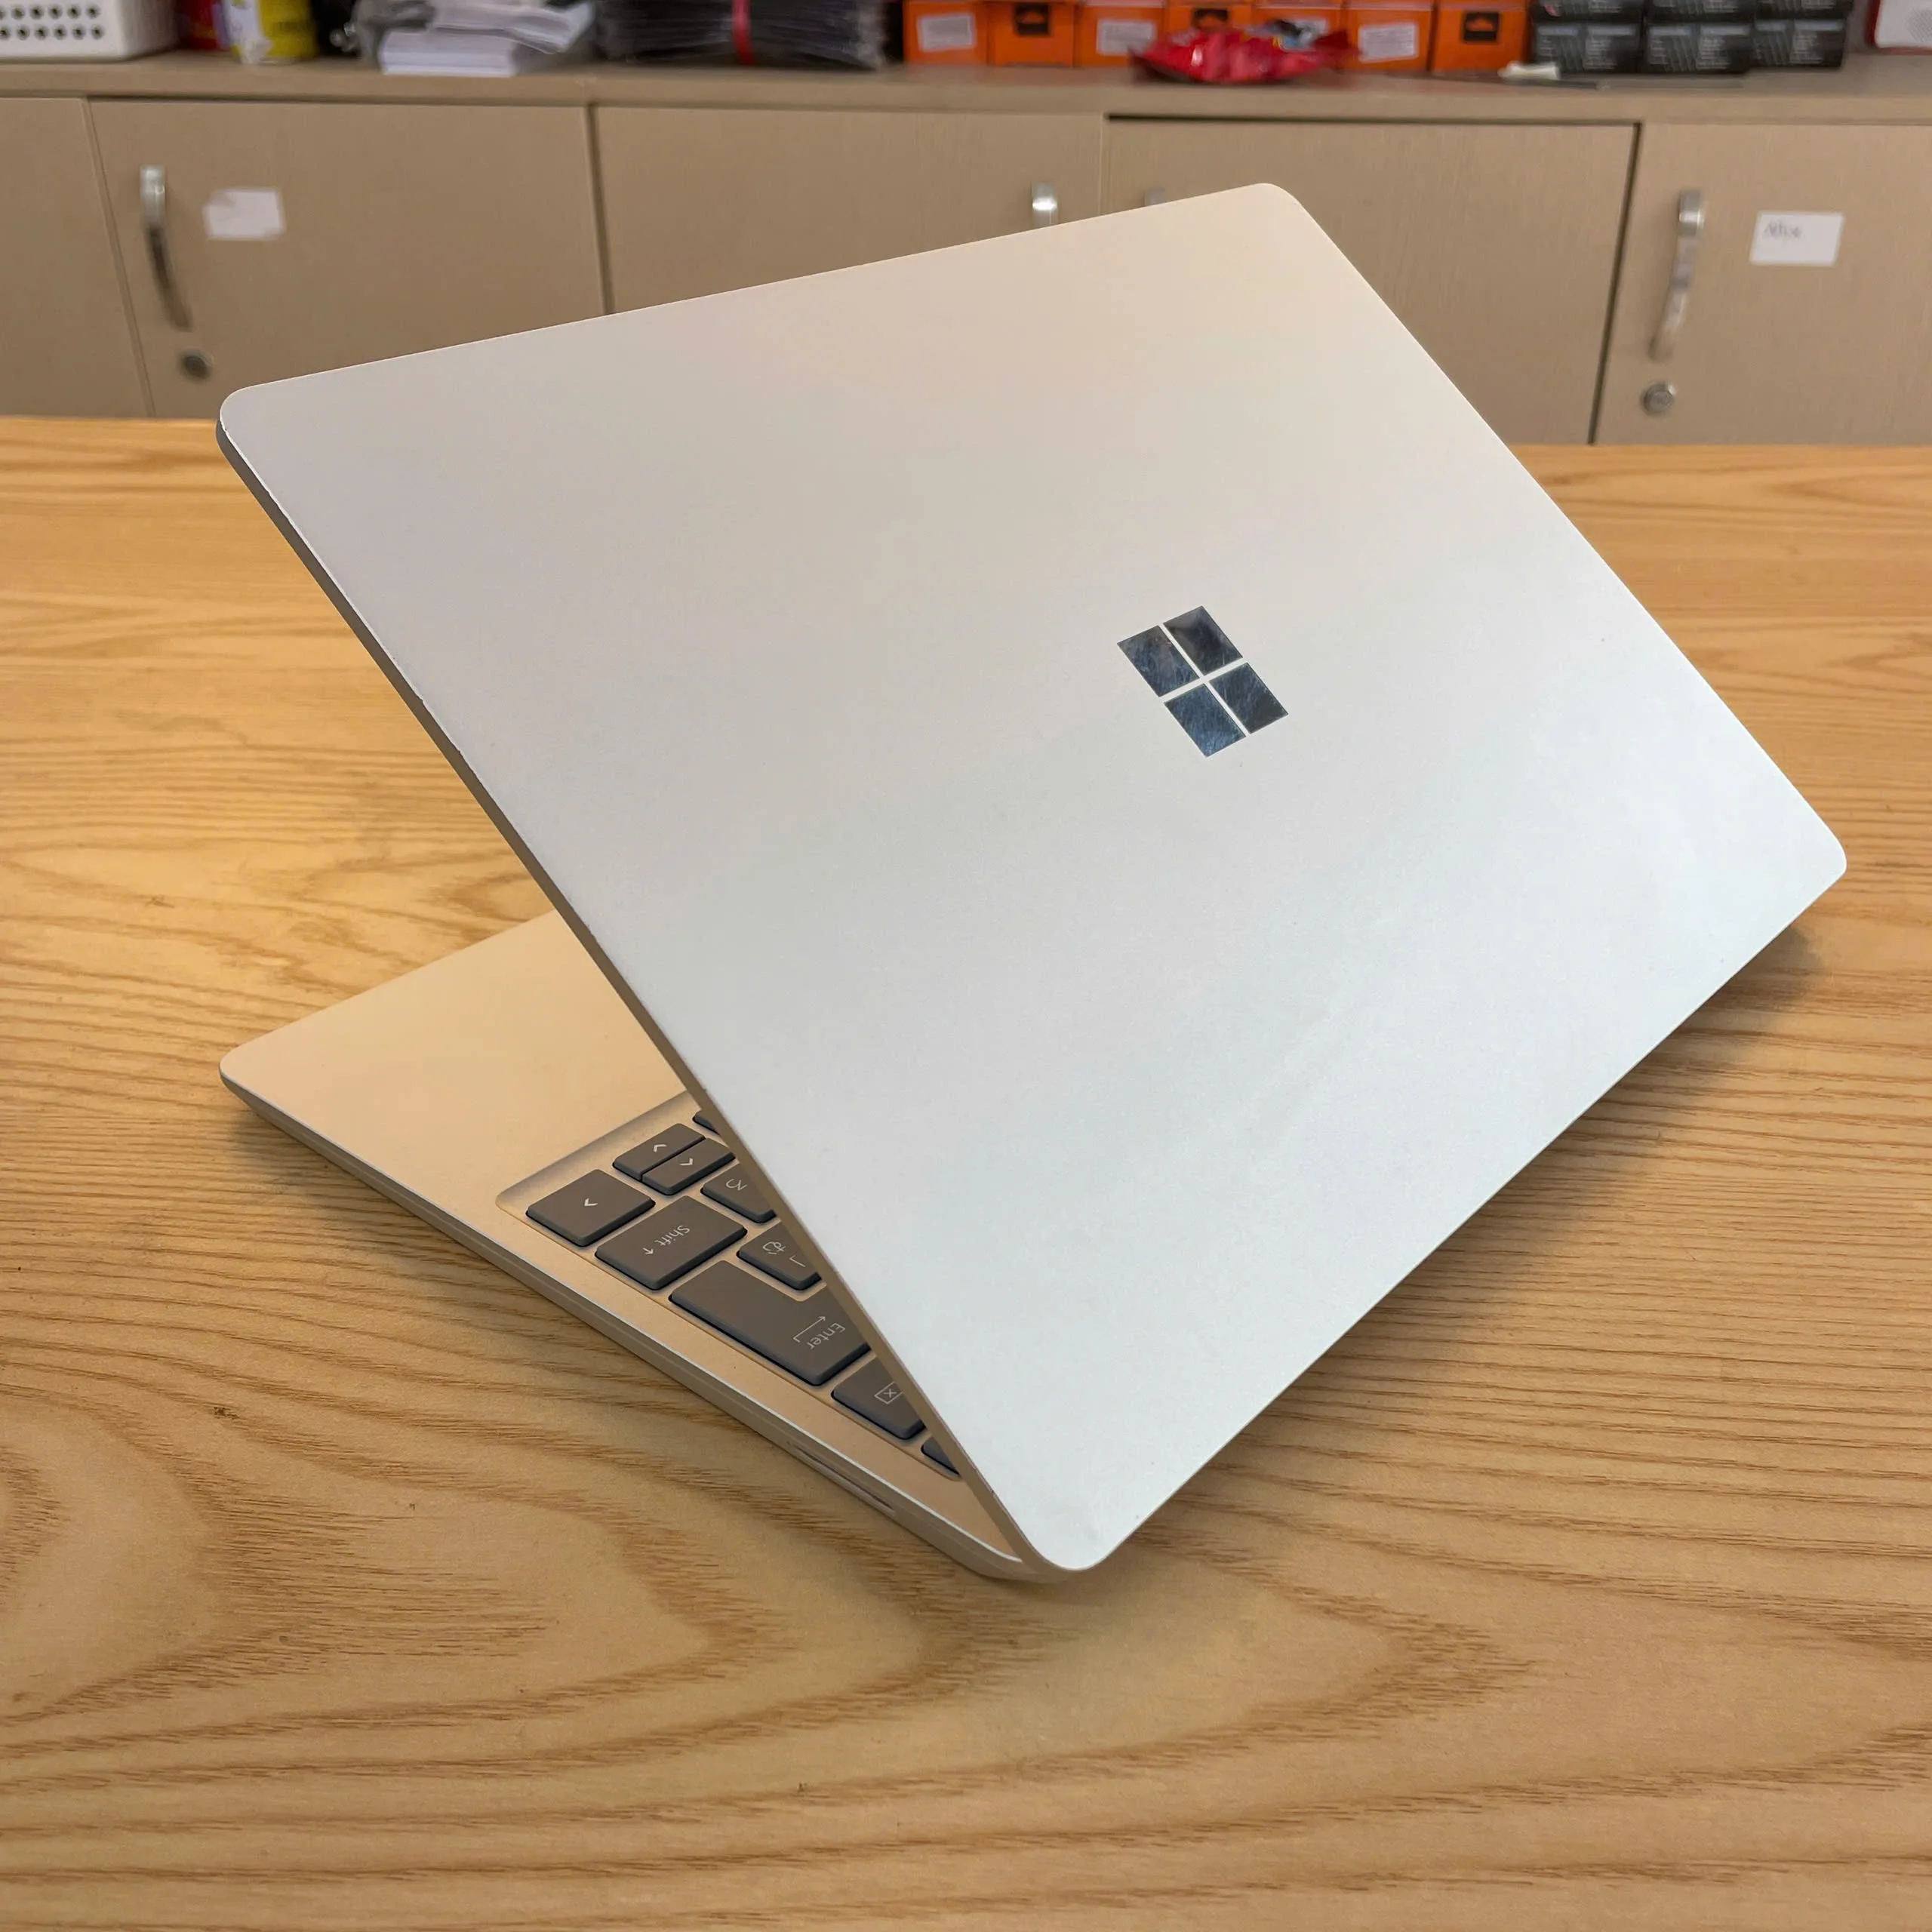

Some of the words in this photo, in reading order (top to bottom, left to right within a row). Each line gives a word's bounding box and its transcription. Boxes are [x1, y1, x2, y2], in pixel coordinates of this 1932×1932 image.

[726, 1179, 747, 1190] ろ
[654, 1225, 690, 1245] Shift
[762, 1241, 786, 1254] む
[806, 1323, 845, 1349] Enter
